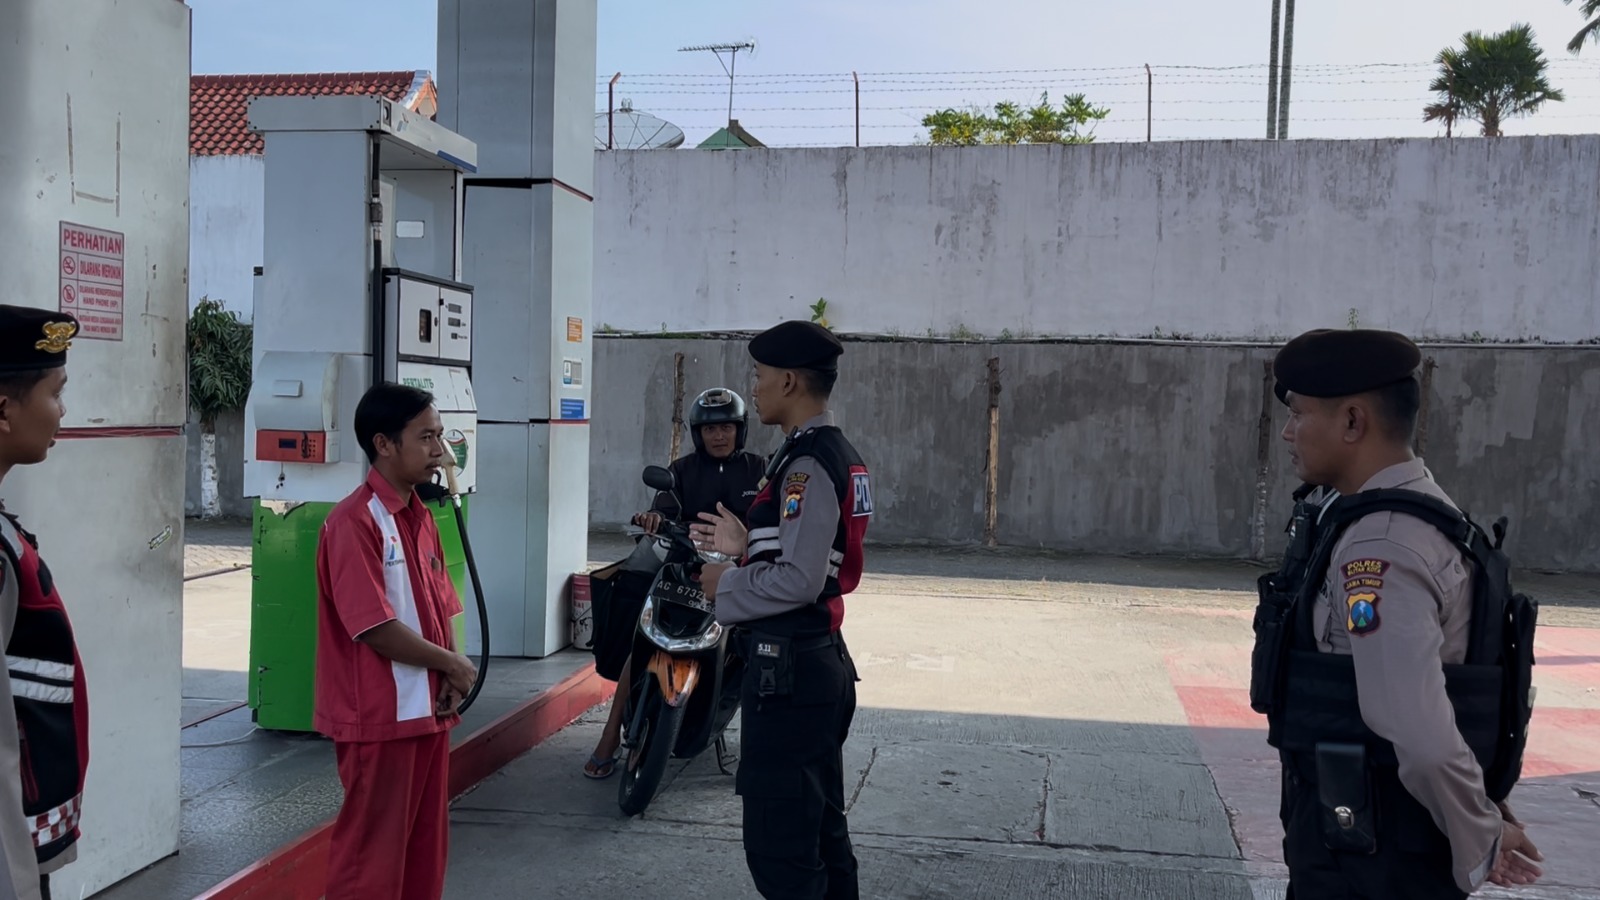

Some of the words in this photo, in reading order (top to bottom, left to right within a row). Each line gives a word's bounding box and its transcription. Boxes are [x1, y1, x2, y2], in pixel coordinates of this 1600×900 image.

[63, 228, 122, 255] PERHATIAN
[80, 260, 101, 276] DILARANG
[95, 298, 109, 307] PHONE
[1347, 560, 1382, 570] POLRES
[1347, 566, 1365, 576] BLITAR
[1346, 579, 1361, 590] JAWA
[1361, 579, 1381, 588] TIMUR
